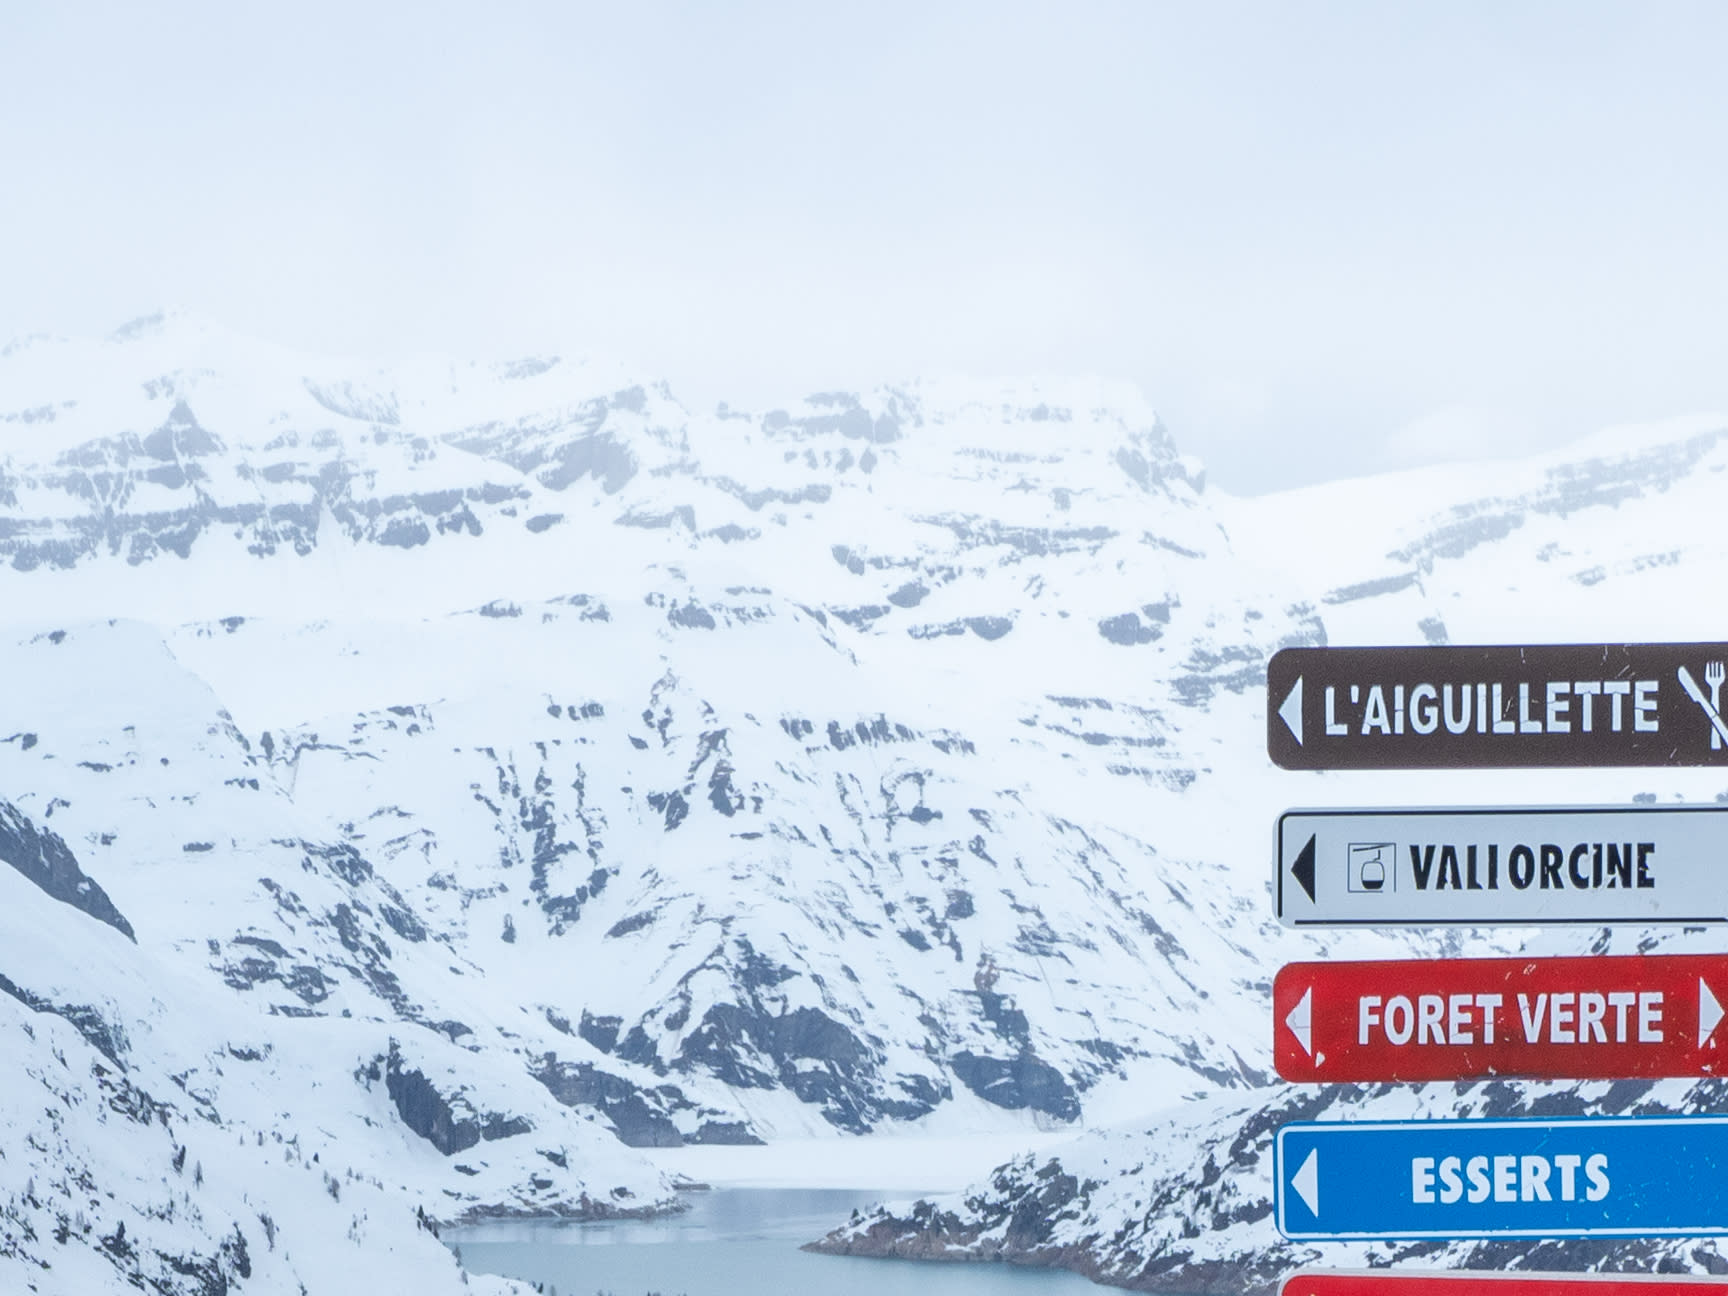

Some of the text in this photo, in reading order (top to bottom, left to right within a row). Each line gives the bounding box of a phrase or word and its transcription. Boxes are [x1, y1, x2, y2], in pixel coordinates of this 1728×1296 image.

[1325, 680, 1659, 735] L'AIGUILLETTE
[1358, 991, 1664, 1045] FORET VERTE
[1412, 1153, 1610, 1204] ESSERTS
